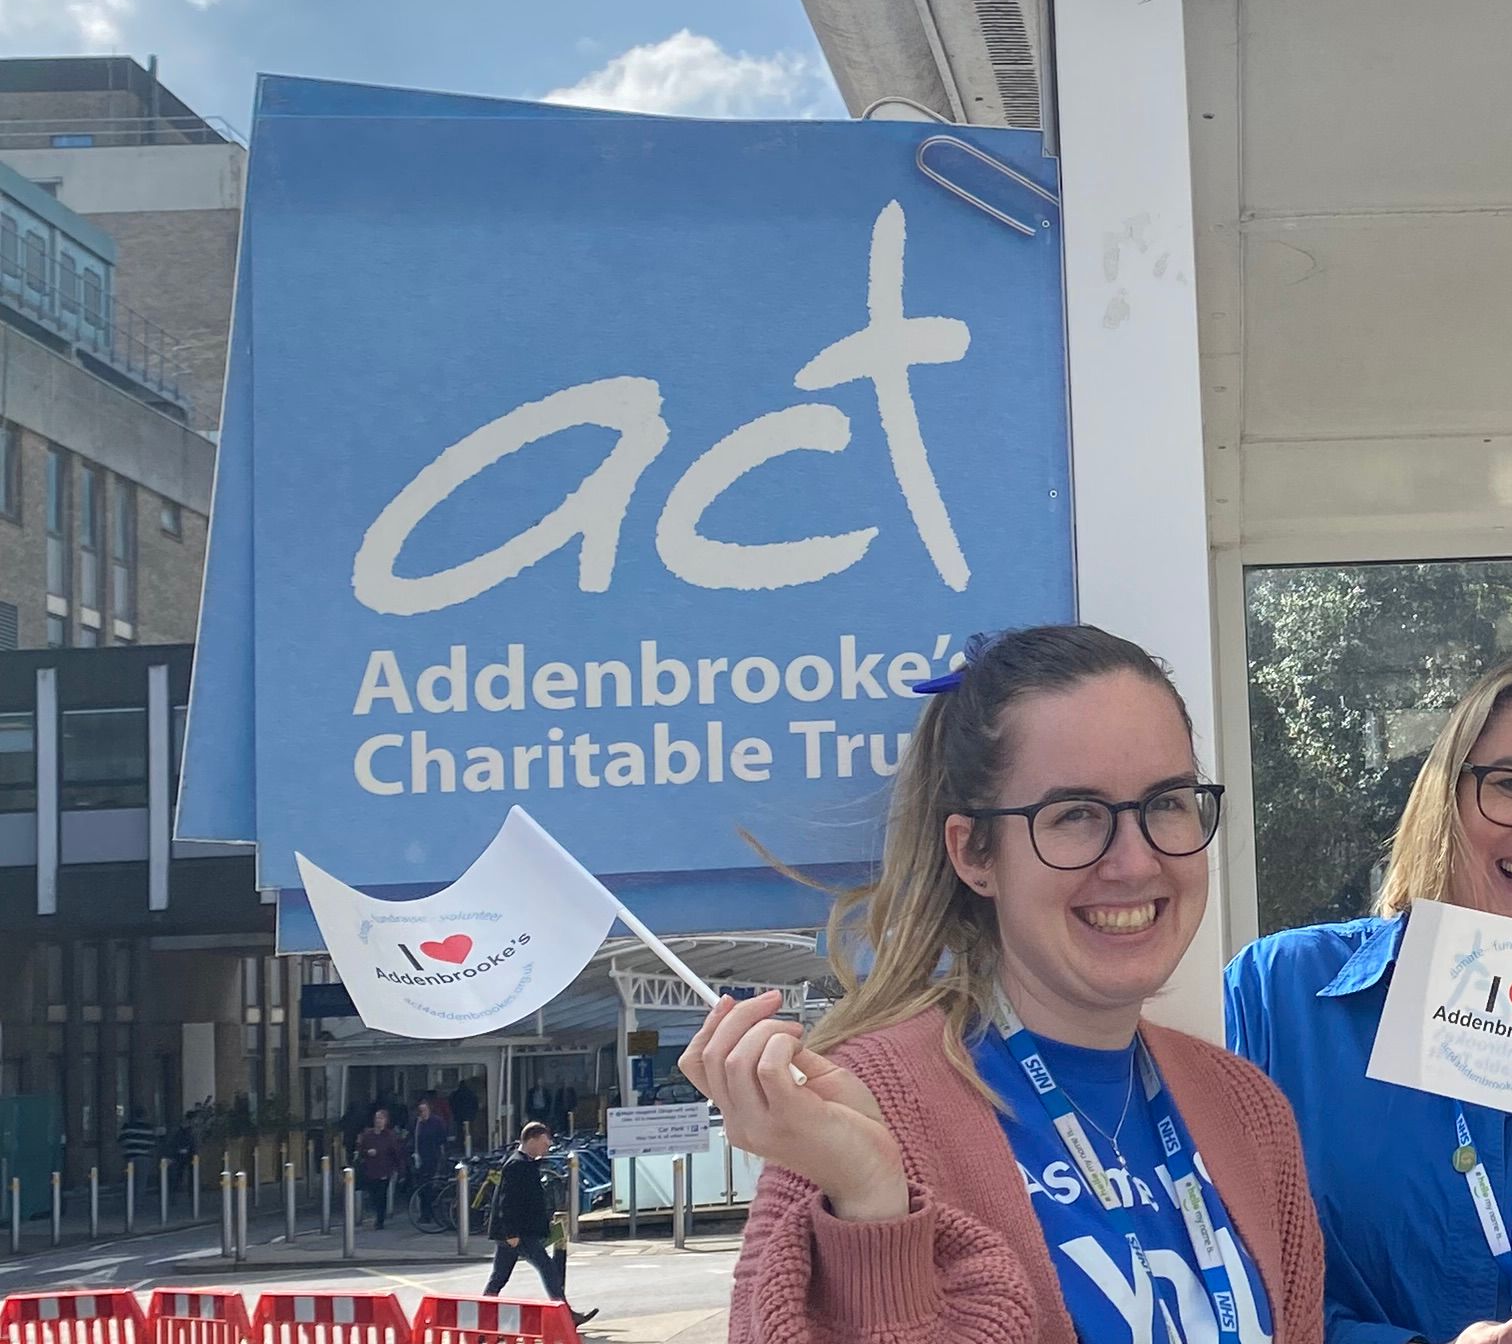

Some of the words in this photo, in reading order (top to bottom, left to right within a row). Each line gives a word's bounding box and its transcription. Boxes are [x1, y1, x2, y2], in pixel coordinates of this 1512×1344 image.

[352, 199, 971, 616] act
[352, 633, 966, 716] Addenbrooke'
[354, 721, 773, 796] Charitable
[789, 719, 910, 780] Tru
[375, 932, 532, 986] Addenbrooke's
[397, 943, 424, 971] I
[1485, 976, 1501, 1013] I
[1025, 1058, 1051, 1093] NHS
[1159, 1120, 1178, 1153] NHS
[1457, 1117, 1470, 1145] NHS
[1218, 1293, 1235, 1330] NHS
